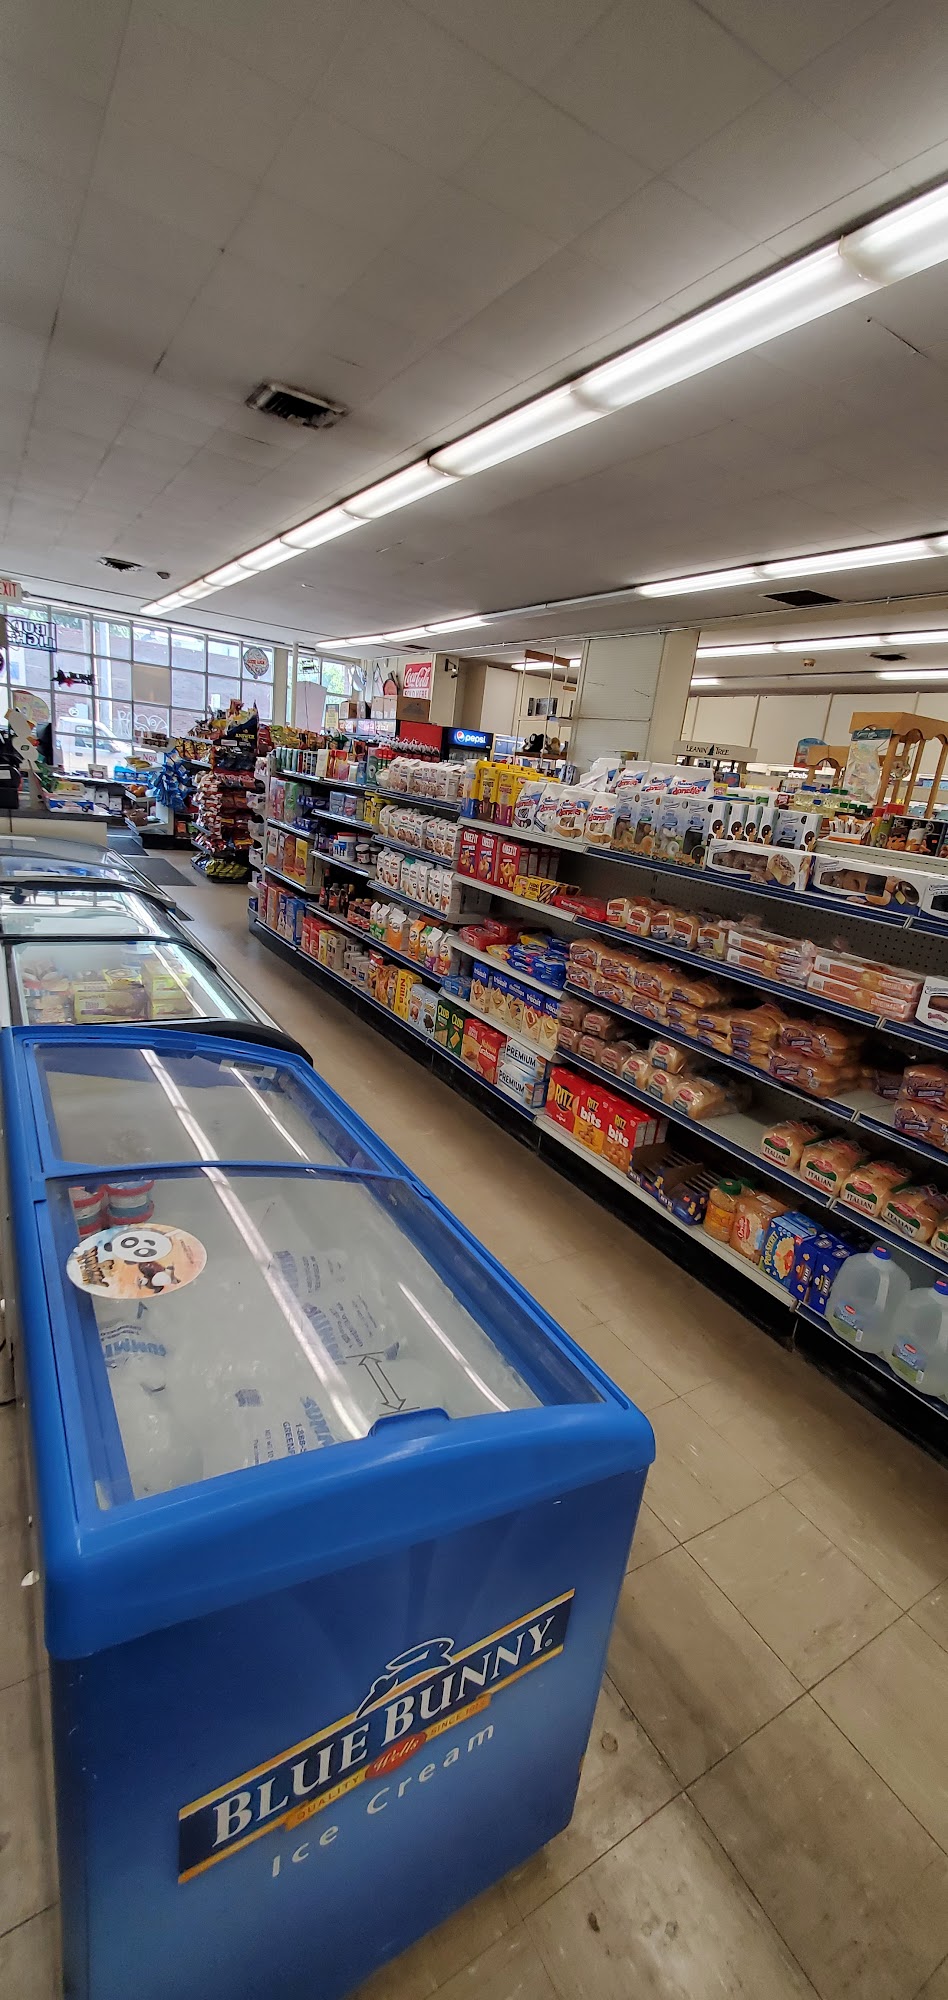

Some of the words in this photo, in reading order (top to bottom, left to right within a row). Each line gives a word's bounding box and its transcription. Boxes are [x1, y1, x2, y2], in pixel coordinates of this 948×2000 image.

[404, 666, 431, 687] Coca-Cola
[416, 690, 427, 698] HERE
[465, 734, 486, 744] pepsi
[715, 747, 729, 755] TREE
[506, 1044, 536, 1068] PREMIUM
[499, 1070, 525, 1093] PREMIUM
[555, 1084, 574, 1111] RITZ
[587, 1097, 599, 1110] RITZ
[580, 1106, 602, 1128] bits
[614, 1114, 626, 1130] RITZ
[607, 1123, 630, 1148] bits
[764, 1146, 786, 1163] ITALIAN
[807, 1170, 832, 1188] ITALIAN
[846, 1194, 873, 1211] ITALIAN
[887, 1211, 914, 1235] ITALIAN
[431, 1714, 459, 1735] SINCE
[374, 1738, 420, 1772] Wells
[212, 1723, 370, 1847] BLUE
[271, 1824, 340, 1877] Ice
[366, 1724, 494, 1815] Cream
[297, 1776, 359, 1820] QUALITY
